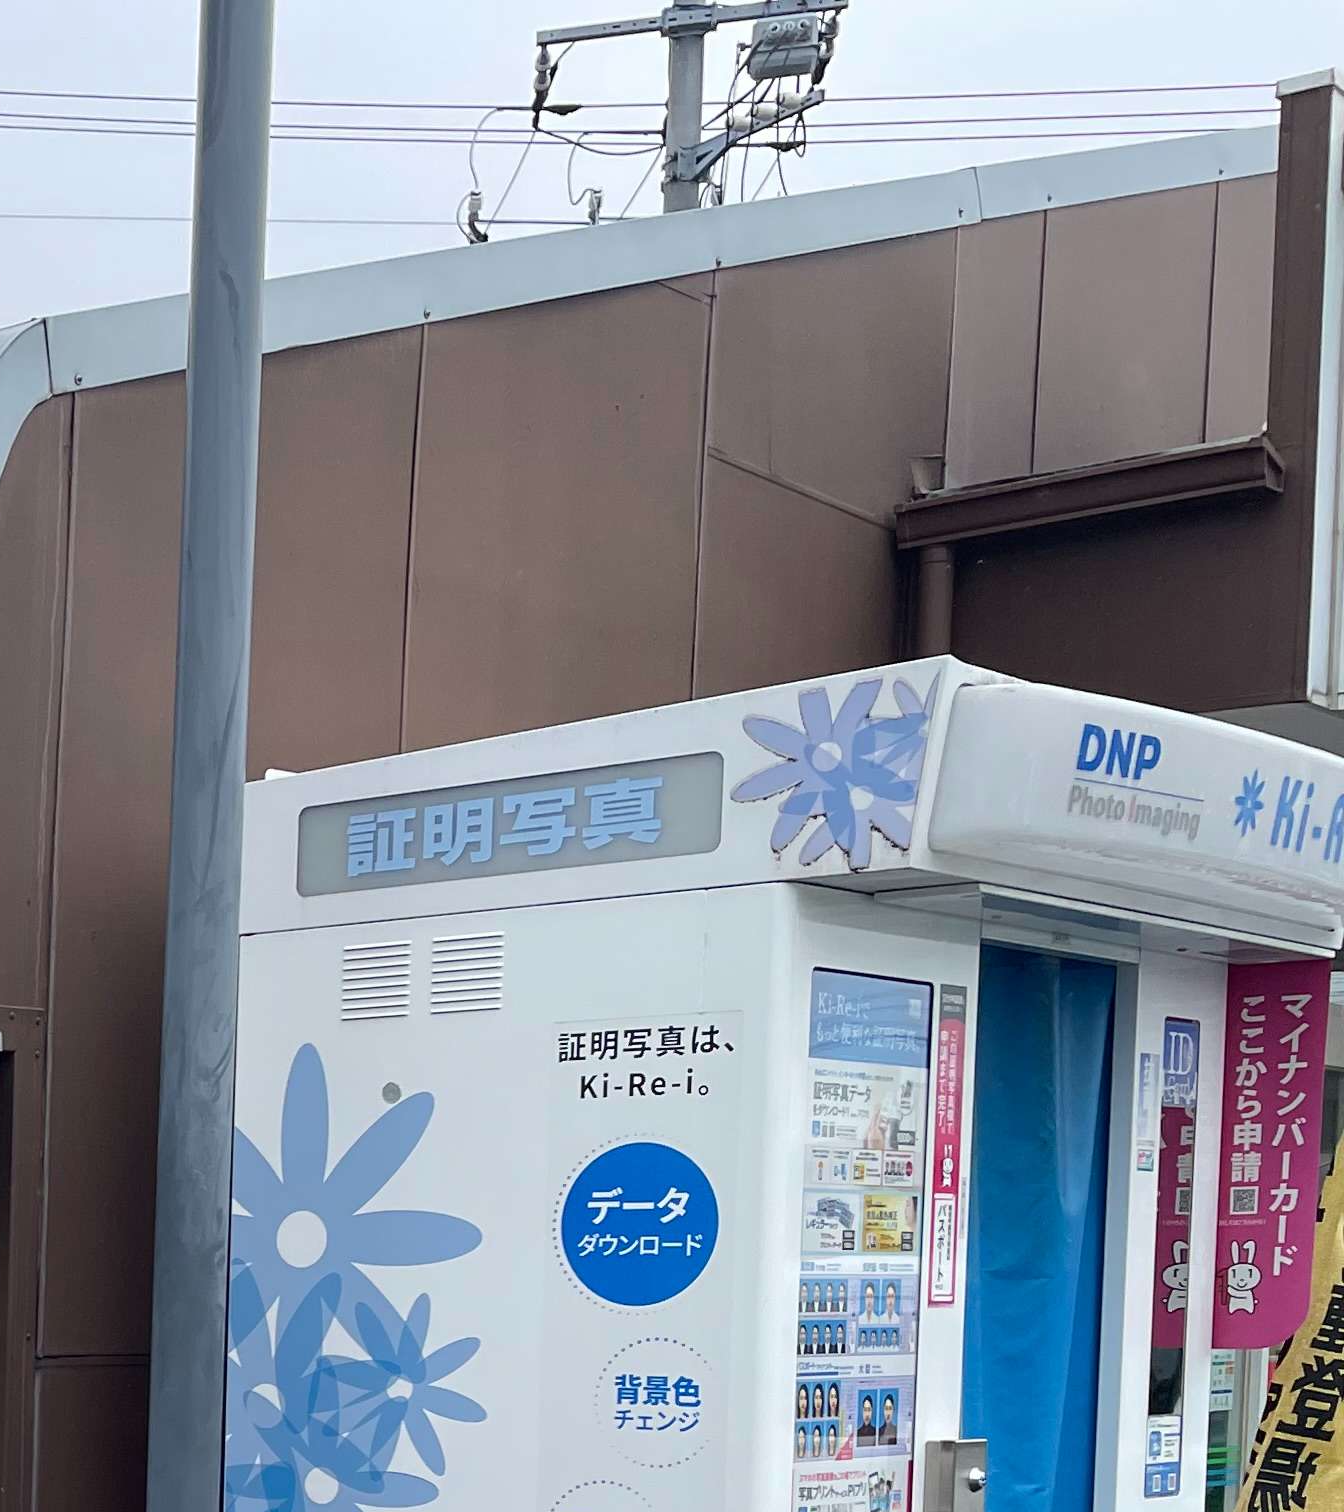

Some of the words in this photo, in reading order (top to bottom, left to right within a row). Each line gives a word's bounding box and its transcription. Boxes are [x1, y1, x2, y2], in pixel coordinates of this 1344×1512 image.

[1075, 722, 1162, 780] DNP
[346, 775, 664, 878] 証明写真
[1067, 784, 1126, 822] Photo
[1128, 795, 1201, 842] Imaging
[557, 1024, 735, 1063] 証明写真は、
[1229, 994, 1268, 1184] ここから申請
[1268, 992, 1313, 1277] マイナンバーカード
[586, 1186, 691, 1225] データ
[577, 1233, 703, 1258] ダウンロード
[614, 1374, 702, 1408] 背景色
[614, 1410, 701, 1433] チェンジ
